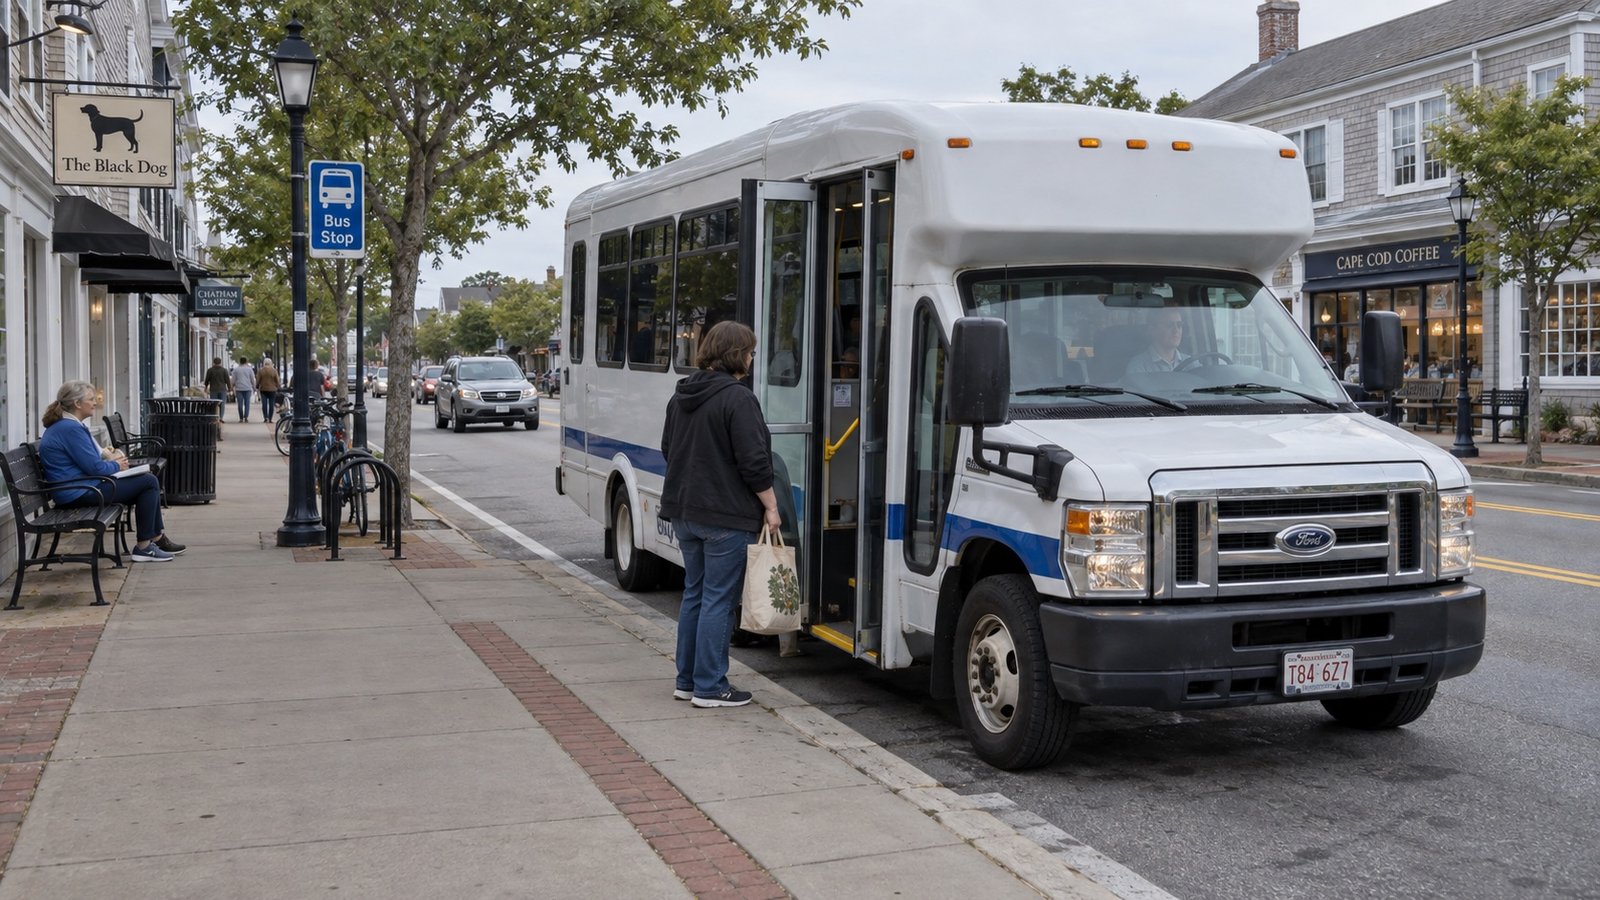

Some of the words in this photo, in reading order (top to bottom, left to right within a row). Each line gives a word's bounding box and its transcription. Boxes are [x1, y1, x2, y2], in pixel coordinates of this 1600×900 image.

[62, 157, 91, 171] The
[95, 158, 133, 173] Black
[137, 160, 168, 177] Dog
[324, 214, 351, 227] Bus
[321, 230, 354, 247] Stop
[1336, 254, 1364, 270] CAPE
[1366, 251, 1392, 267] COD
[1395, 245, 1440, 264] COFFEE
[197, 290, 238, 298] CHATHAM
[1295, 531, 1323, 546] Ford
[1288, 663, 1315, 685] T84
[1322, 660, 1349, 682] 6Z7
